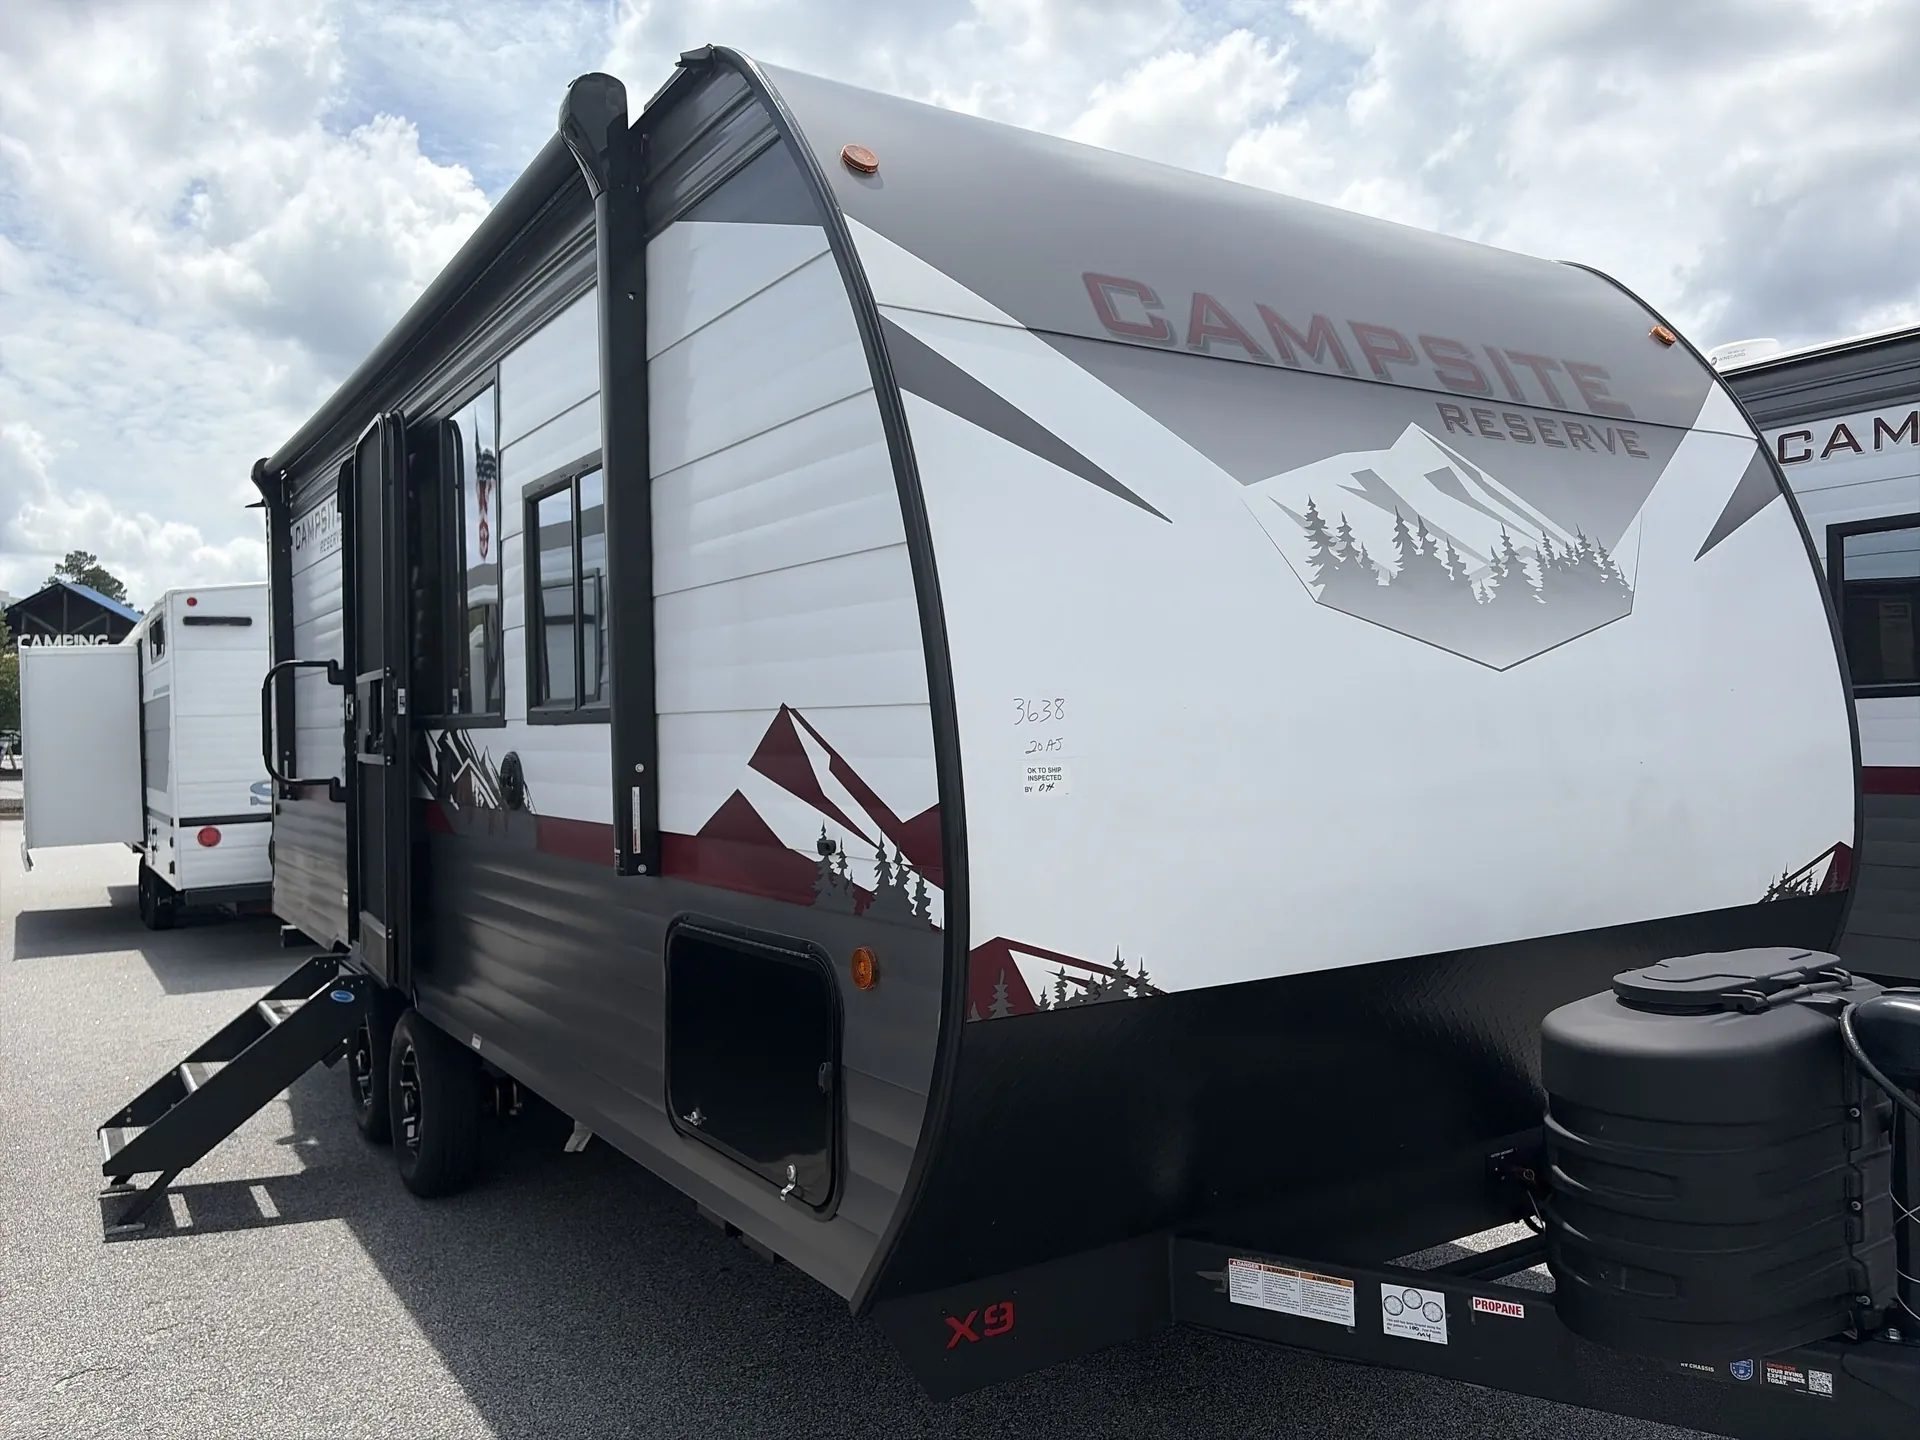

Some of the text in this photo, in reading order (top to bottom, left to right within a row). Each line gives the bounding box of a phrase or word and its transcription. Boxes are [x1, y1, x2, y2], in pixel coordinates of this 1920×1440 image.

[1082, 271, 1636, 420] CAMPSITE
[1436, 403, 1650, 459] RESERVE
[1777, 410, 1920, 465] CAM
[295, 498, 341, 551] CAMPSIT
[19, 633, 110, 646] CAMPING
[1013, 698, 1065, 725] 3638
[1027, 774, 1062, 782] INSPECTED
[1047, 766, 1062, 774] SHIP
[1237, 1261, 1260, 1270] DANGER
[1474, 1298, 1523, 1317] PROPANE
[944, 1300, 1015, 1350] X9
[1689, 1363, 1715, 1373] CHASSIS
[1766, 1367, 1803, 1379] YOUR RVING
[1766, 1373, 1806, 1384] EXPERIENCE
